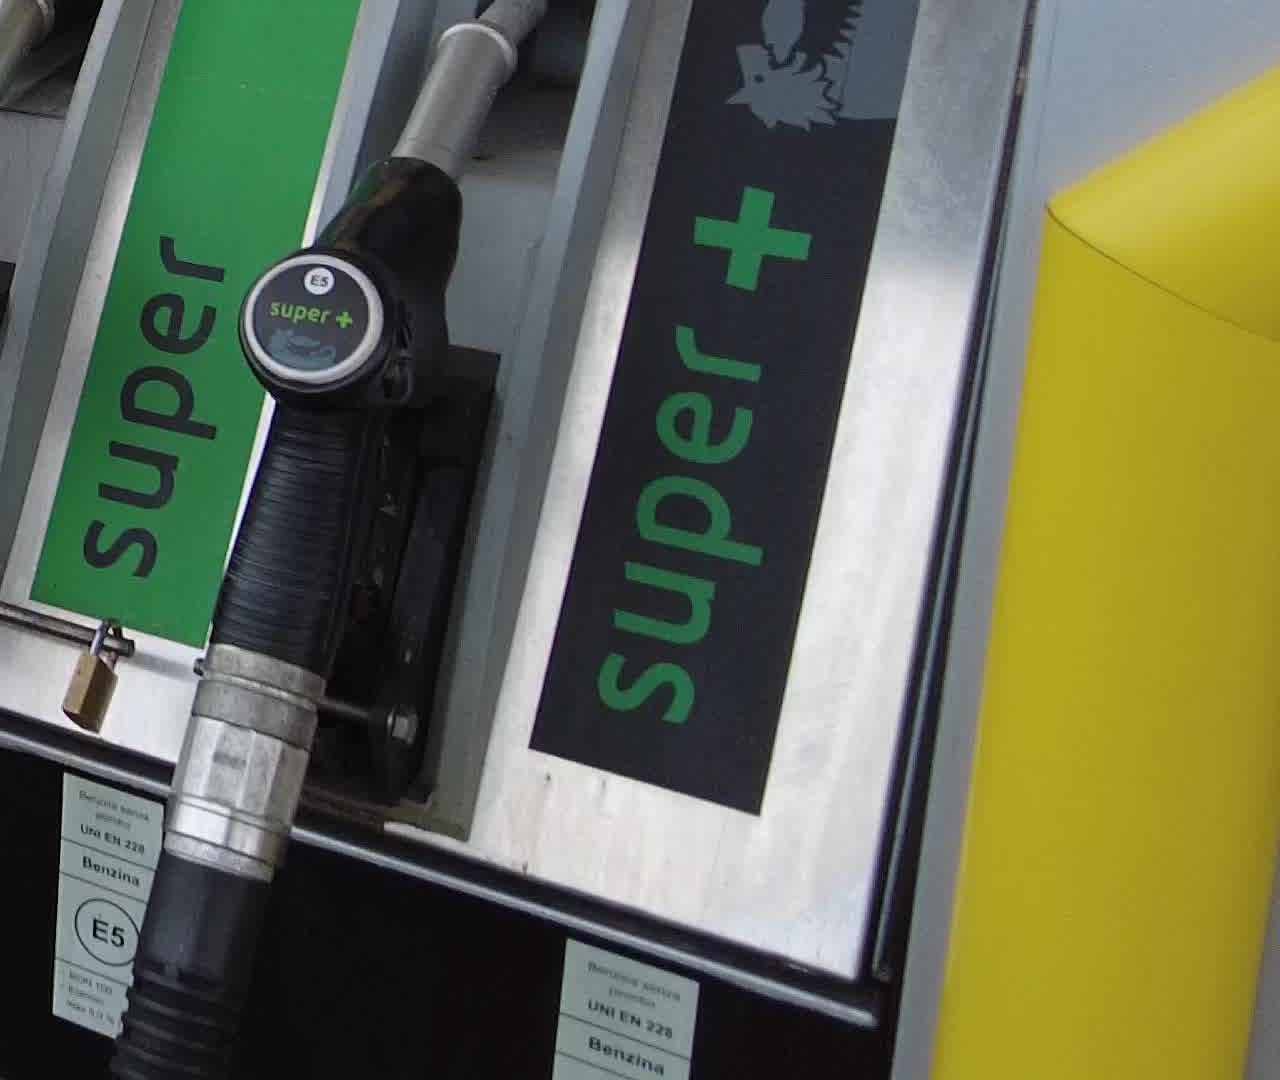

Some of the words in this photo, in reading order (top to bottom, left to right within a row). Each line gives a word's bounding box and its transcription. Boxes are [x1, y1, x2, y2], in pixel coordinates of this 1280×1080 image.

[310, 273, 328, 288] E5
[270, 299, 330, 324] super
[83, 233, 226, 579] super
[596, 324, 763, 724] super
[81, 855, 142, 887] Benzina
[92, 917, 126, 948] E5
[587, 999, 615, 1019] UNI
[619, 1010, 641, 1028] EN
[645, 1021, 673, 1040] 228
[587, 1036, 665, 1077] Benzina
